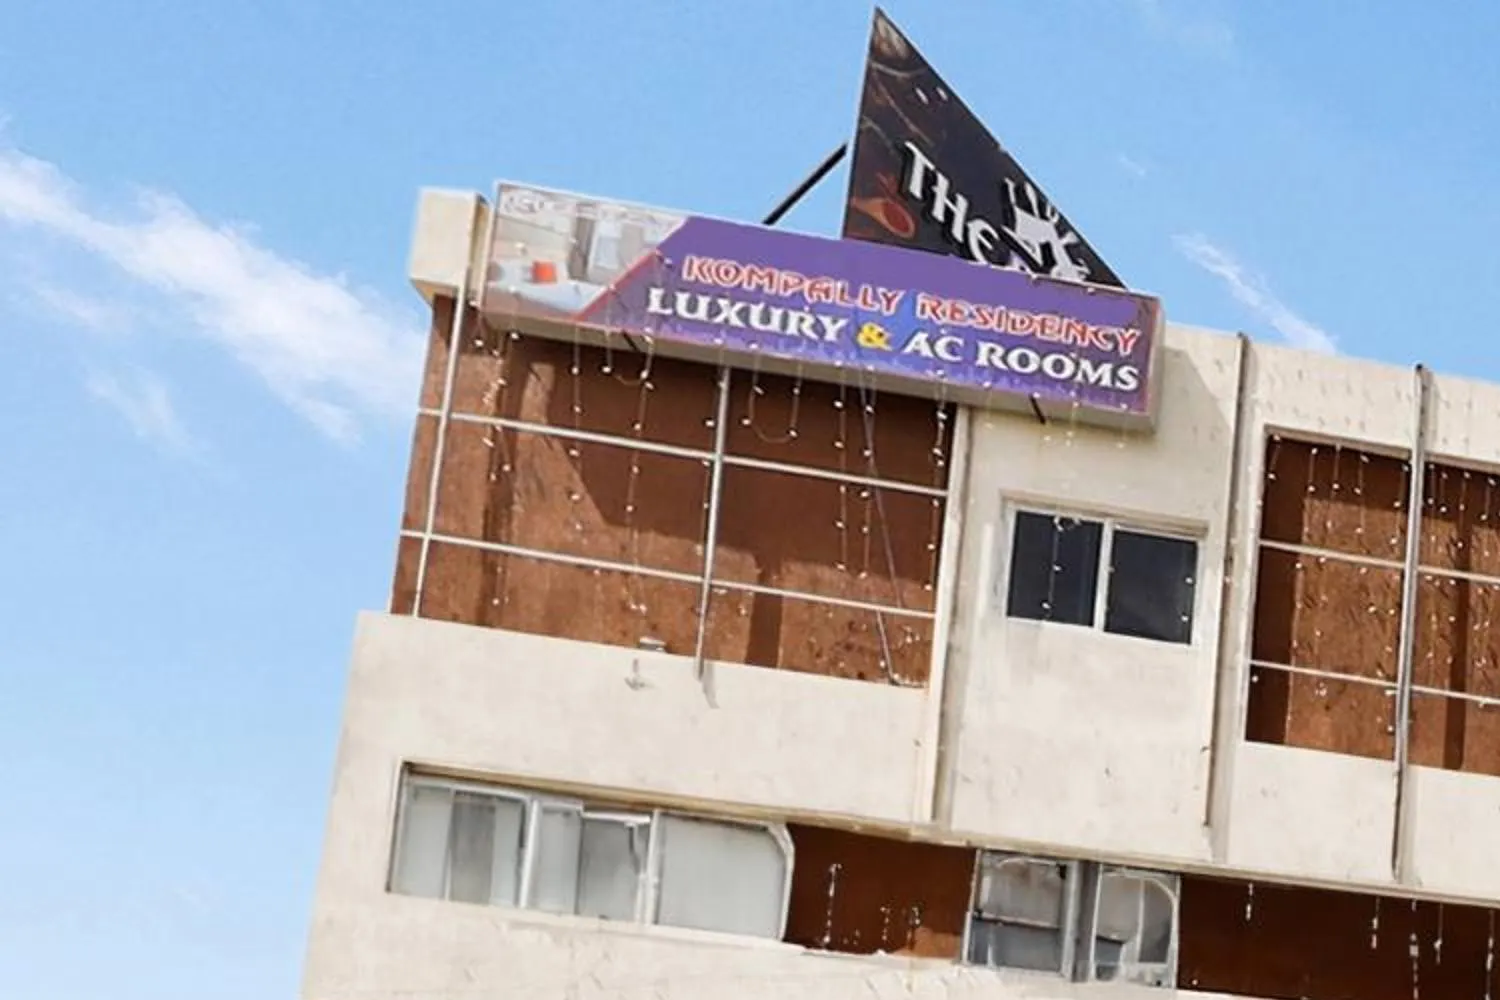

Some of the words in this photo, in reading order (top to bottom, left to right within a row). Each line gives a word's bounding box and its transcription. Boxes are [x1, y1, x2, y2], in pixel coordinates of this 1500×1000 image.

[904, 140, 1000, 265] THE
[646, 287, 848, 343] LUXURY
[856, 322, 893, 351] &
[902, 332, 964, 362] AC
[975, 340, 1140, 391] ROOMS
[682, 255, 904, 316] KOMPALLY
[915, 292, 1142, 357] RESIDENCY
